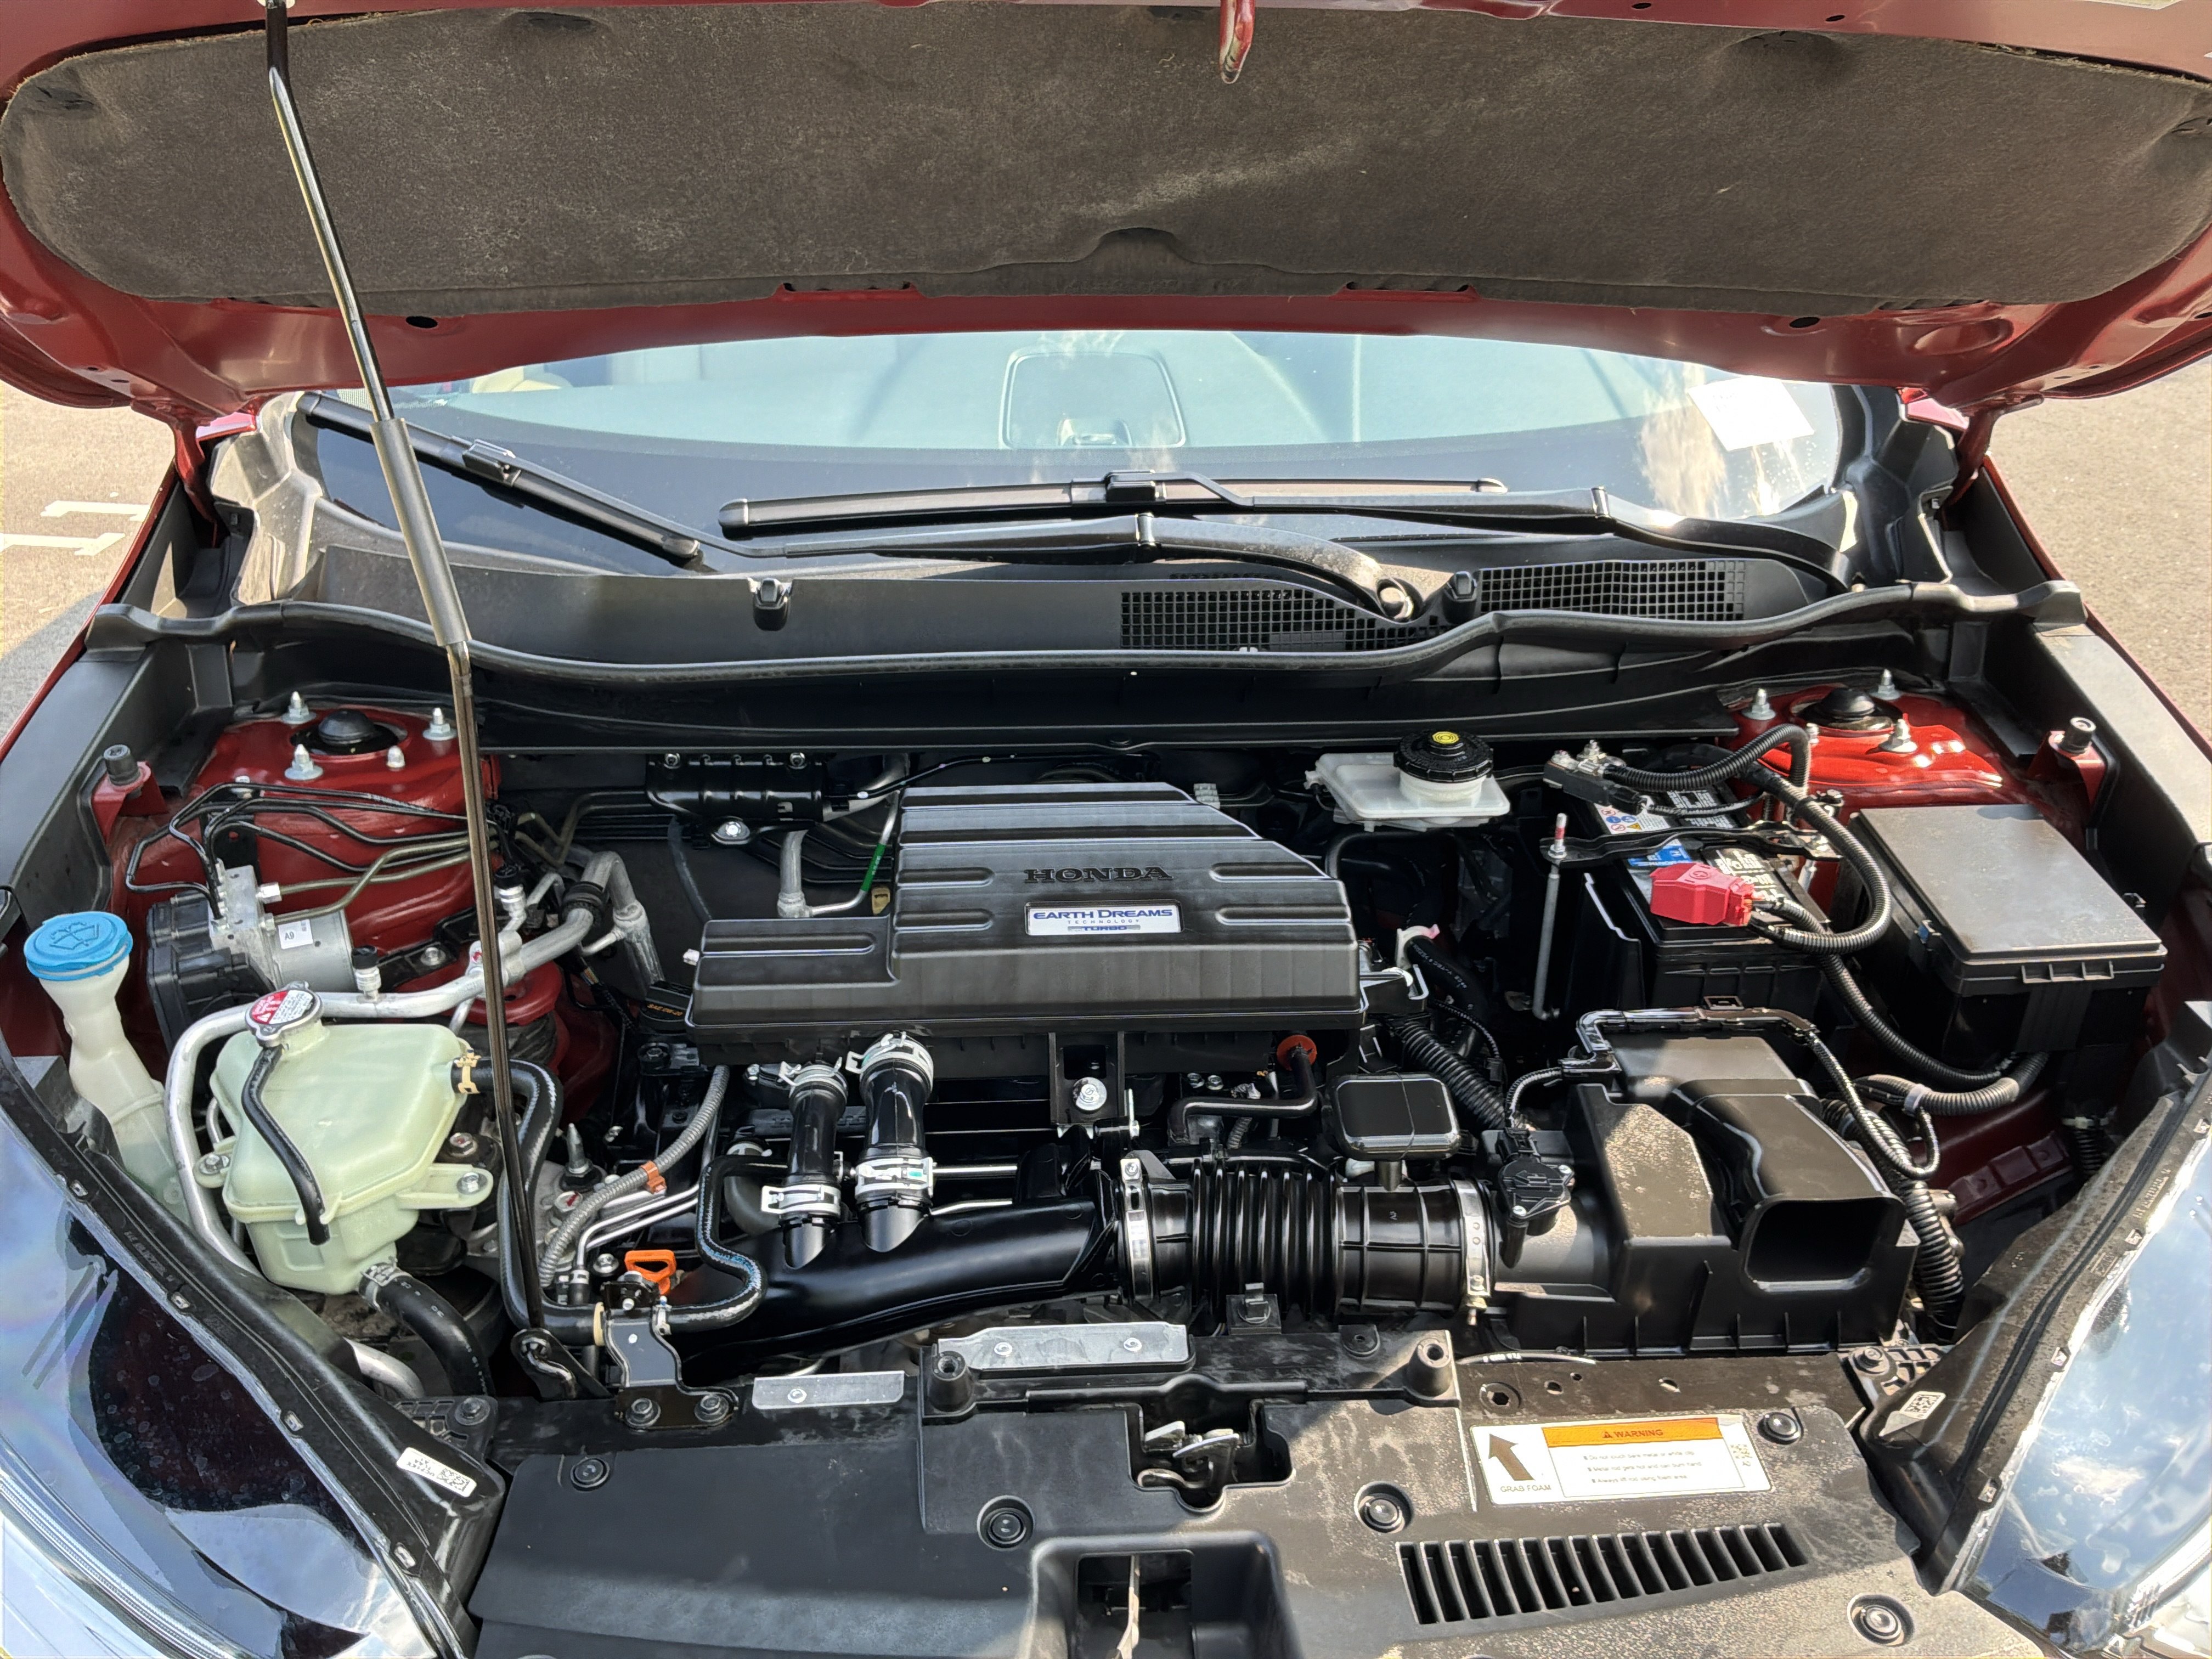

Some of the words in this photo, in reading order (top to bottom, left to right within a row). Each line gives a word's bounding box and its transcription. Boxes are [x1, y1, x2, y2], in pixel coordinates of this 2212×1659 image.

[1024, 867, 1173, 882] HONDA
[1033, 911, 1094, 919] EARTH
[1098, 910, 1173, 919] DREAMS
[285, 932, 295, 940] A9
[1613, 1429, 1663, 1438] WARNING
